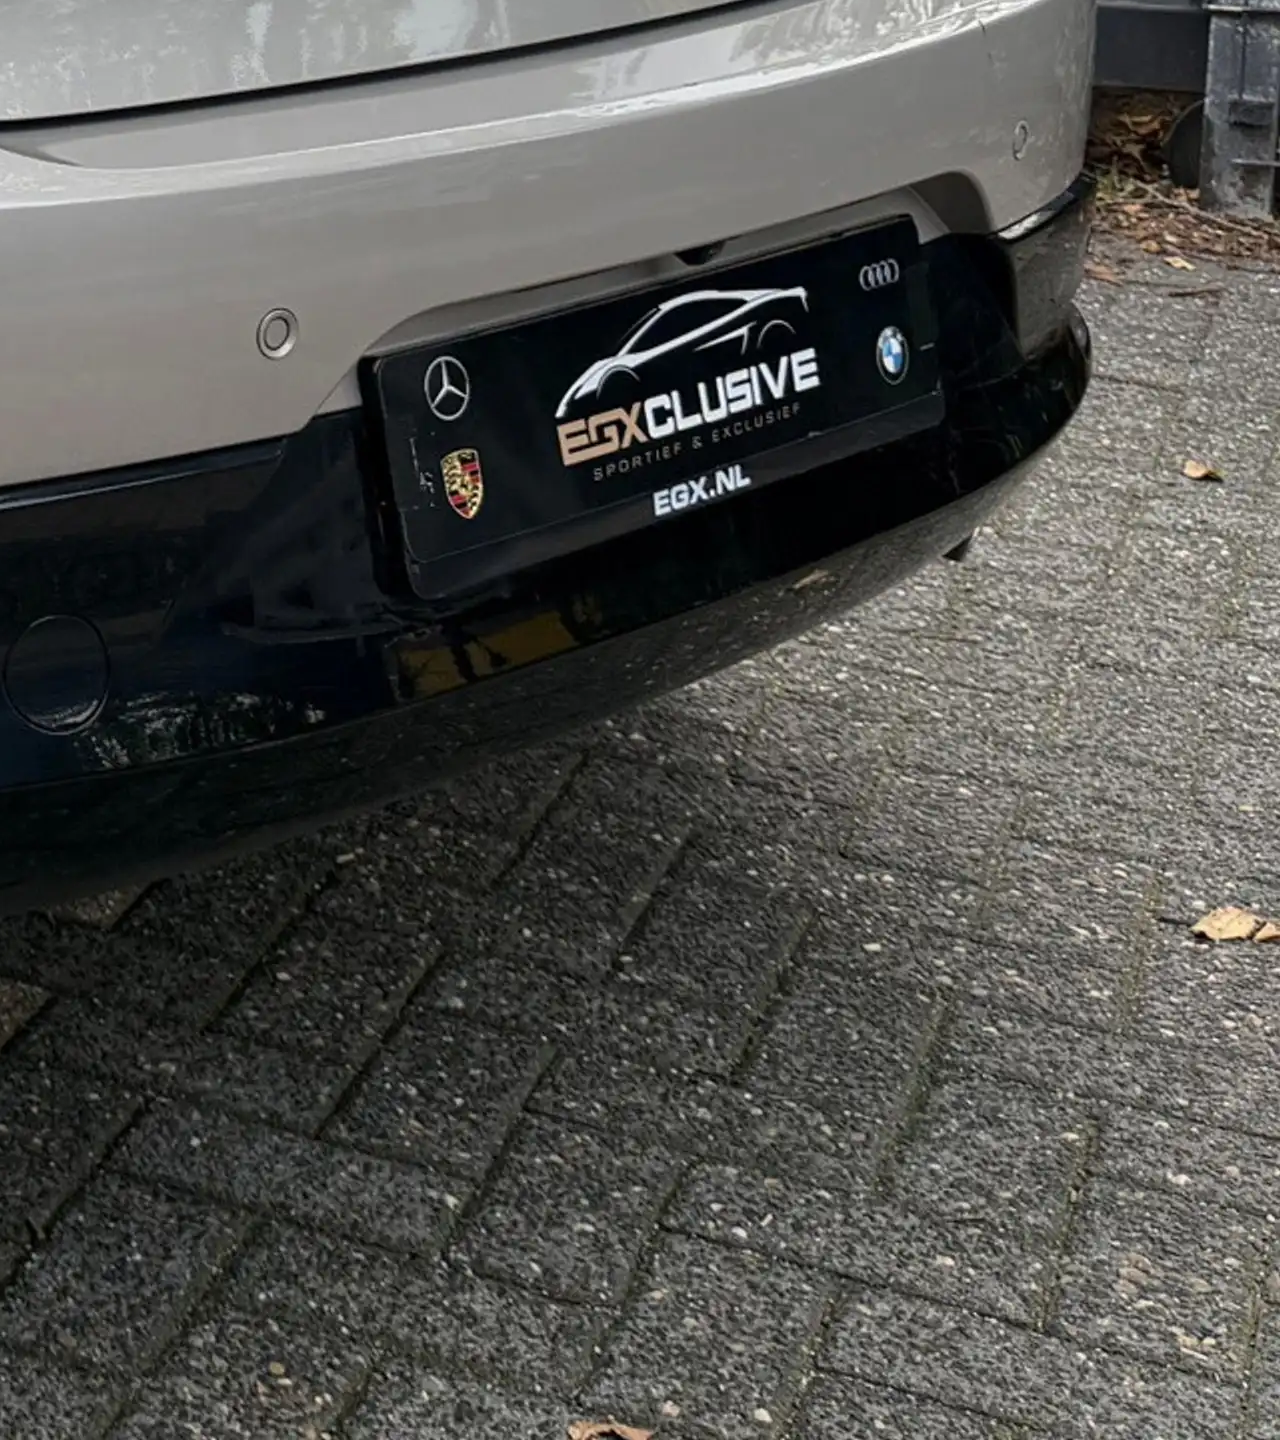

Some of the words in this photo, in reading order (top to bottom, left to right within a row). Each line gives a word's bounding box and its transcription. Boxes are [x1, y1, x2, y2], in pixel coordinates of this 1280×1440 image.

[592, 441, 683, 483] SPORTIEF
[691, 435, 704, 450] &
[711, 401, 802, 443] EXCLUSIEF
[652, 463, 753, 517] EGX.NL
